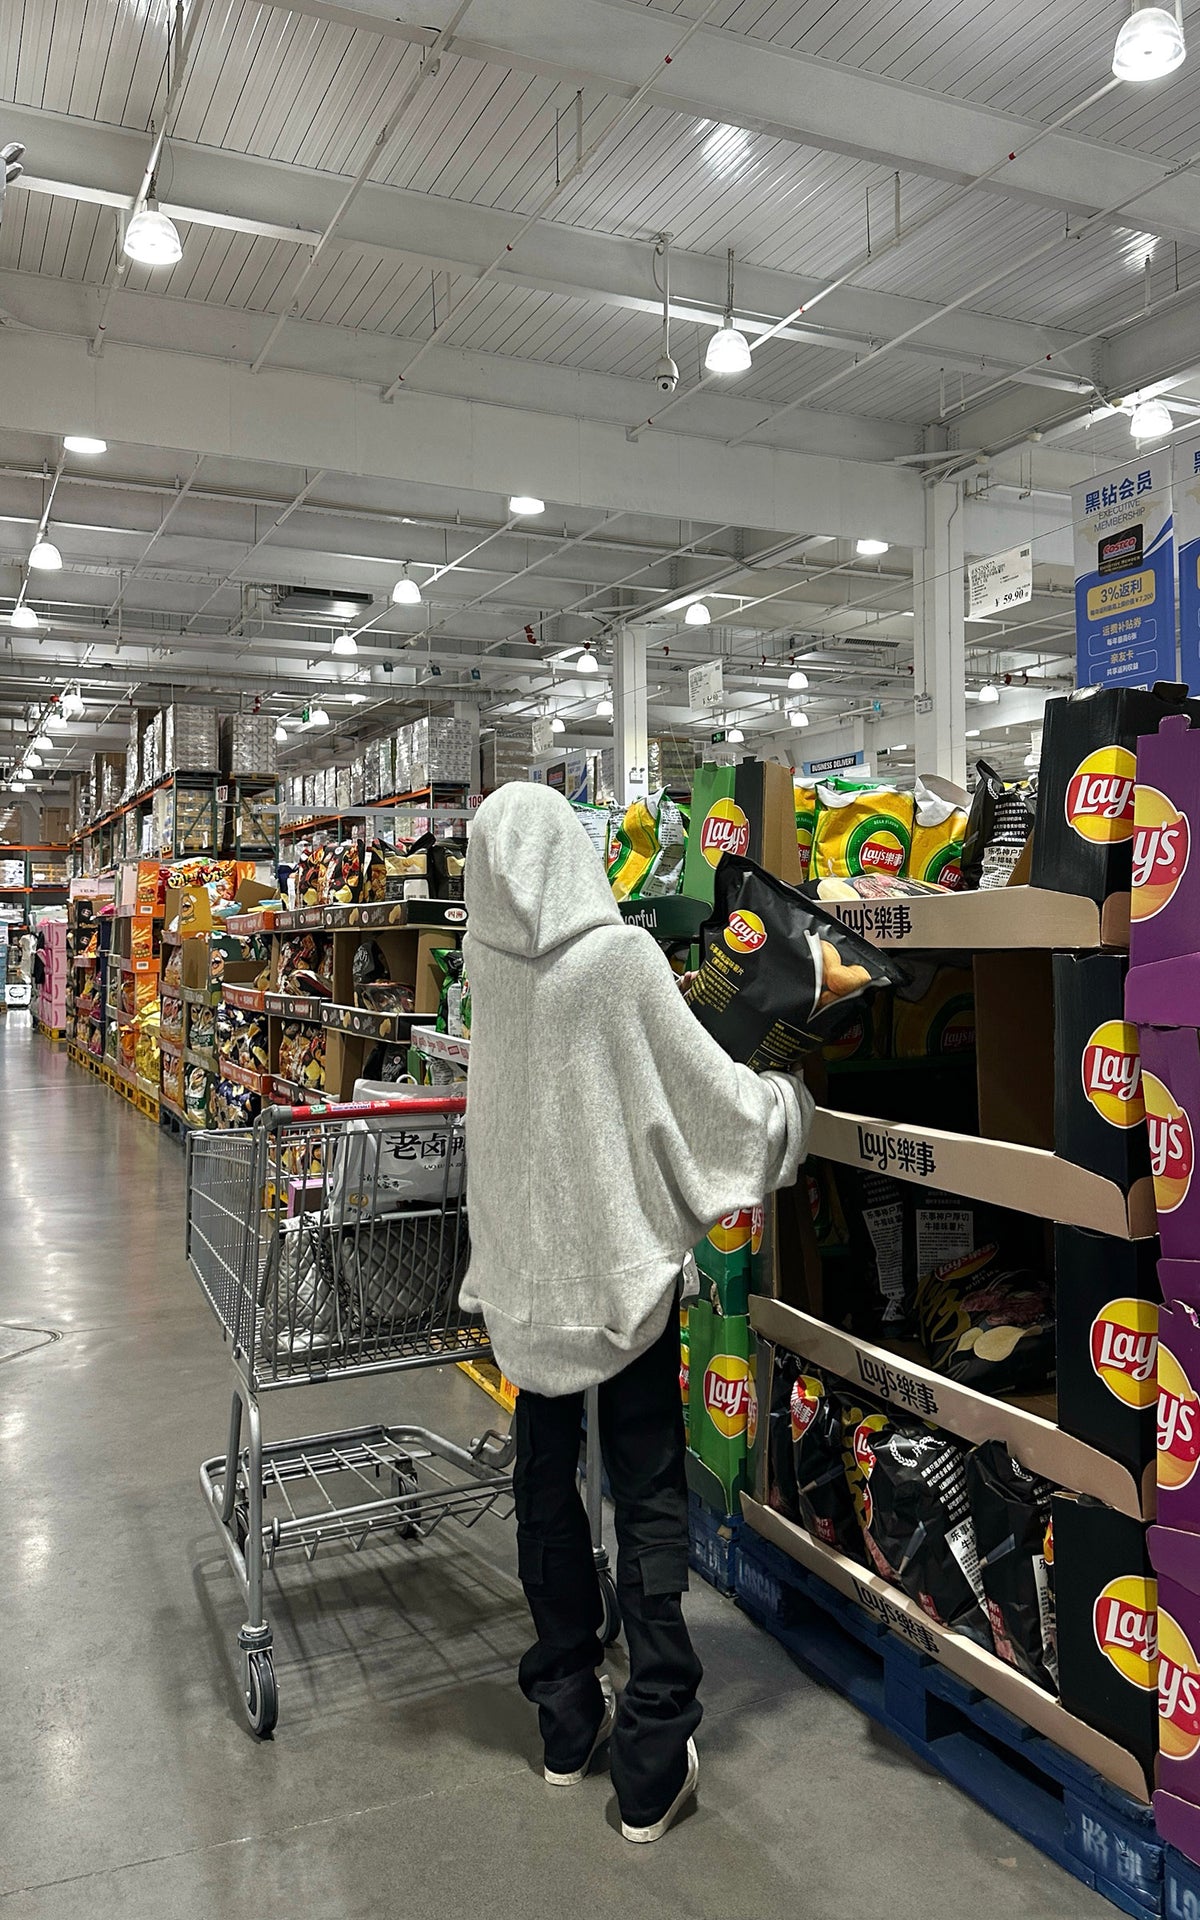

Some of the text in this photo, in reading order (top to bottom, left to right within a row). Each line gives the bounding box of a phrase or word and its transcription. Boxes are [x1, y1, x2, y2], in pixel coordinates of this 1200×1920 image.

[1085, 470, 1152, 514] 黑钻会员
[1094, 507, 1145, 532] MEMBERSHIP
[1099, 501, 1140, 519] EXECUTIVE
[1103, 537, 1137, 555] COSTCO
[1003, 589, 1024, 605] 59.90
[1101, 578, 1142, 603] 3%返利
[811, 757, 855, 772] BUSINESS DELIVERY
[468, 796, 482, 808] 109
[1073, 775, 1134, 818] Lay
[1131, 821, 1180, 887] y's
[730, 915, 763, 944] Lay's
[920, 1211, 969, 1221] 乐事神户厚切
